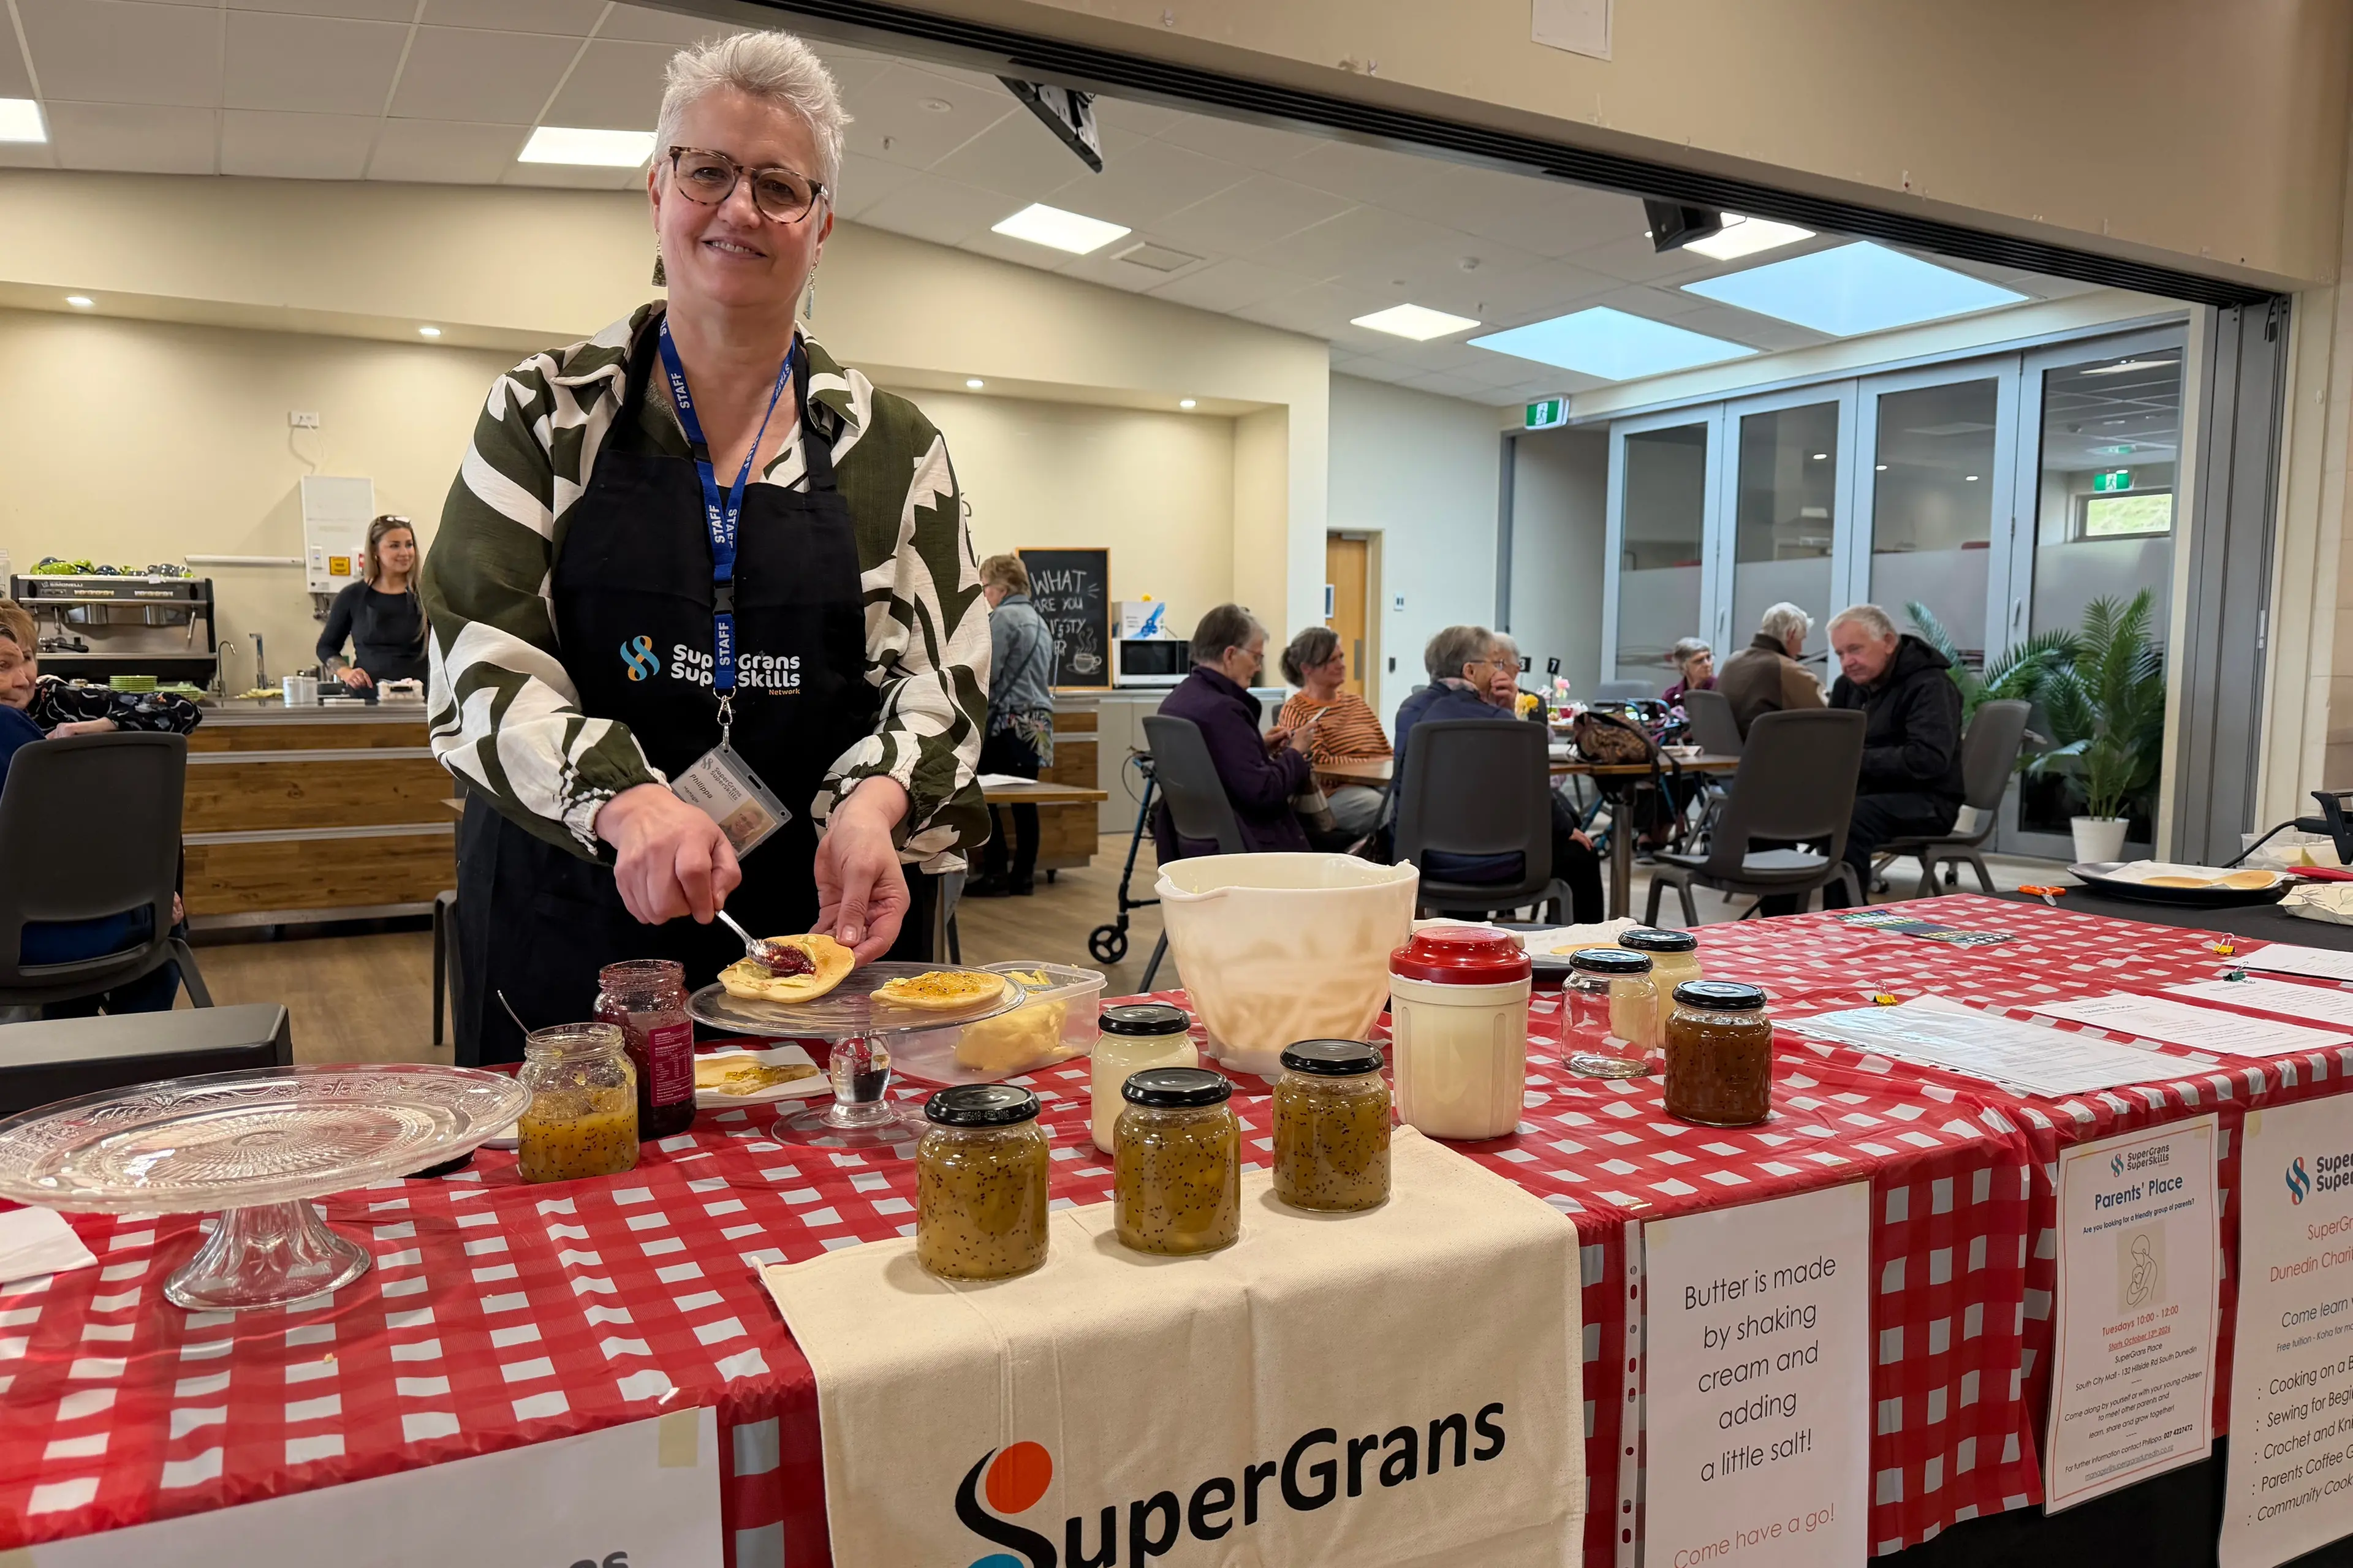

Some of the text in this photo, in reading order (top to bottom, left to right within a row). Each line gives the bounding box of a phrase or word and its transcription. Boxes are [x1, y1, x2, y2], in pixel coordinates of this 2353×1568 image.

[671, 373, 691, 409] STAFF
[709, 504, 726, 543] STAFF
[1029, 569, 1088, 596] WHAT
[1033, 596, 1083, 612] ARE YOU
[673, 644, 800, 670] SupGrans
[718, 623, 730, 666] STAFF
[710, 770, 738, 801] SuperSkills
[714, 767, 742, 797] SuperGrans
[2127, 1153, 2169, 1171] SuperSkills
[2128, 1145, 2170, 1162] SuperGrans
[2095, 1176, 2183, 1210] Parents' Place
[2093, 1224, 2103, 1233] you
[2104, 1218, 2122, 1229] looking
[2135, 1210, 2153, 1221] friendly
[2154, 1206, 2168, 1216] group
[2175, 1198, 2194, 1210] parents?
[1684, 1255, 1836, 1311] Butter is made
[2270, 1257, 2318, 1282] Dunedin
[1703, 1303, 1817, 1350] by shaking
[2102, 1320, 2135, 1336] Tuesdays
[2137, 1312, 2154, 1326] 10:00
[2161, 1305, 2179, 1318] 12:00
[2282, 1307, 2317, 1328] Come
[2320, 1298, 2348, 1317] learn
[2109, 1341, 2123, 1352] Starts
[2124, 1333, 2147, 1346] October
[2115, 1343, 2163, 1364] SuperGrans Place
[2276, 1342, 2291, 1353] Free
[2292, 1335, 2312, 1349] tuition
[2317, 1329, 2333, 1341] Koha
[2334, 1325, 2344, 1336] for
[1698, 1340, 1819, 1393] cream and
[2075, 1381, 2092, 1392] South
[2093, 1376, 2105, 1386] City
[2105, 1371, 2117, 1381] Mall
[2121, 1366, 2131, 1376] 132
[2131, 1358, 2150, 1373] Hillside
[2150, 1357, 2159, 1366] Rd
[2159, 1353, 2175, 1364] South
[2175, 1346, 2197, 1358] Dunedin
[2270, 1370, 2317, 1395] Cooking
[2320, 1364, 2335, 1379] on
[2338, 1360, 2346, 1373] a
[1718, 1392, 1797, 1430] adding
[2064, 1411, 2083, 1422] Come
[2084, 1405, 2101, 1416] along
[2101, 1402, 2109, 1412] by
[2110, 1393, 2131, 1407] yourself
[2139, 1388, 2150, 1397] with
[2151, 1383, 2164, 1395] your
[2163, 1378, 2181, 1391] young
[2181, 1371, 2203, 1383] children
[2105, 1409, 2121, 1420] meet
[2121, 1403, 2136, 1414] other
[2136, 1396, 2158, 1411] parents
[2158, 1391, 2170, 1403] and
[2267, 1403, 2308, 1428] Sewing
[2311, 1396, 2327, 1413] for
[2088, 1404, 2175, 1439] learn, share and grow together!
[1700, 1428, 1812, 1482] a little salt!
[2065, 1465, 2074, 1474] For
[2074, 1458, 2091, 1471] further
[2091, 1449, 2121, 1465] information
[2121, 1441, 2142, 1455] contact
[2142, 1434, 2164, 1447] Philippa:
[2163, 1430, 2173, 1440] 027
[2264, 1430, 2311, 1460] Crochet
[2313, 1421, 2336, 1442] and
[955, 1403, 1506, 1568] SuperGrans
[2262, 1464, 2303, 1492] Parents
[2306, 1450, 2343, 1475] Coffee
[2257, 1486, 2323, 1521] Community
[1673, 1502, 1835, 1568] Come have a go!
